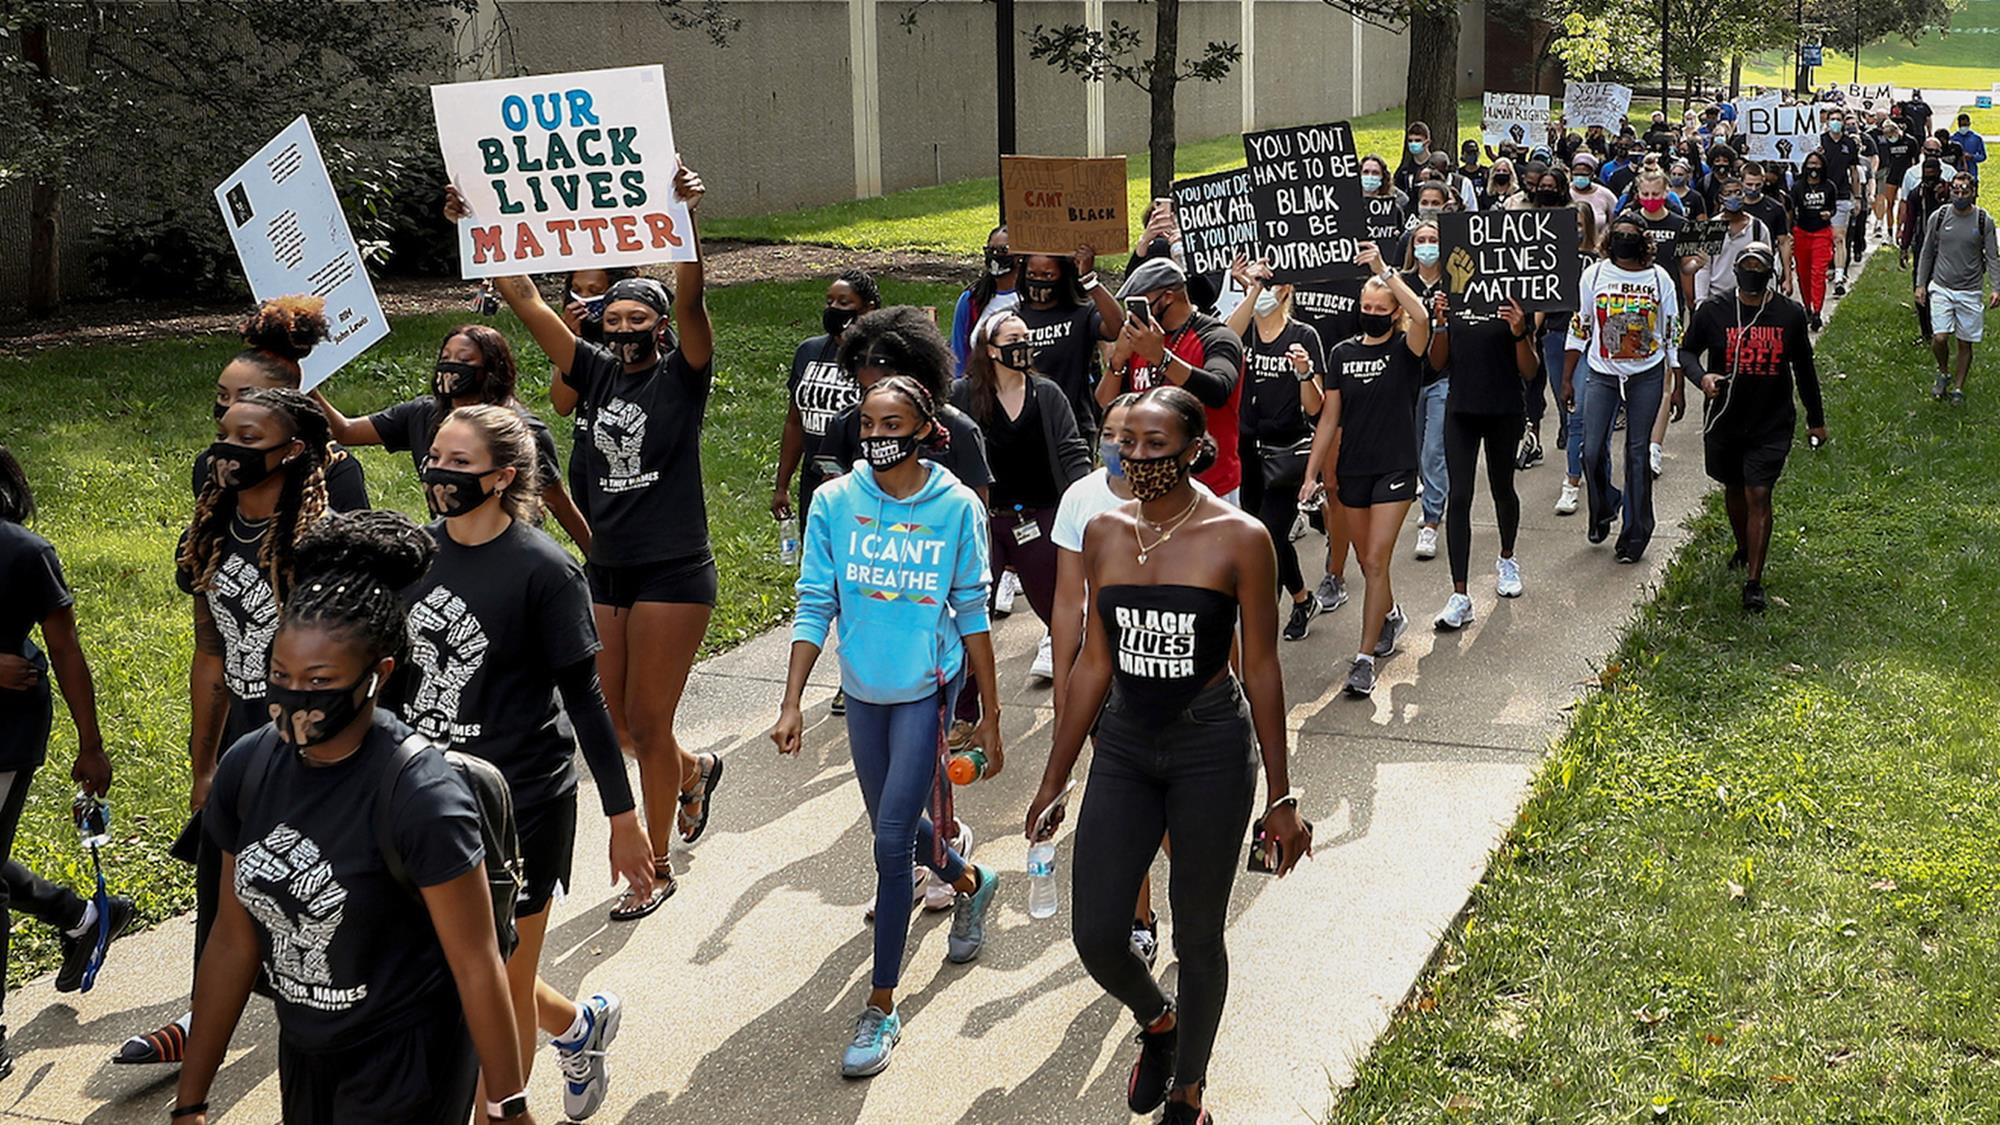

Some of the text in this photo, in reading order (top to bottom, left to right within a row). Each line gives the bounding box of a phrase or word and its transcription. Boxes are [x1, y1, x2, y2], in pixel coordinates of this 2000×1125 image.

[1576, 83, 1615, 96] VOTE
[1849, 84, 1891, 100] BLM
[501, 89, 599, 132] OUR
[1749, 107, 1817, 136] BLM
[477, 126, 642, 175] BLACK
[1249, 135, 1291, 162] YOU
[1005, 161, 1064, 190] ALL
[1253, 154, 1358, 186] HAVE TO BE
[491, 170, 648, 214] LIVES
[1175, 185, 1201, 206] YOU
[1276, 184, 1340, 216] BLACK
[1068, 207, 1116, 222] BLACK
[1265, 215, 1338, 238] TO BE
[1469, 211, 1557, 246] BLACK
[470, 213, 683, 264] MATTER
[1184, 232, 1197, 253] IF
[1199, 226, 1226, 251] YOU
[1479, 244, 1557, 274] LIVES
[1464, 274, 1562, 304] MATTER
[1028, 321, 1072, 341] TUCKY
[1750, 326, 1784, 341] BUILT
[848, 531, 946, 566] I CAN'T
[845, 562, 939, 591] BREATHE
[1115, 606, 1197, 636] BLACK
[1120, 628, 1195, 657] LIVES
[1118, 649, 1195, 679] MATTER
[312, 983, 368, 1002] NAMES
